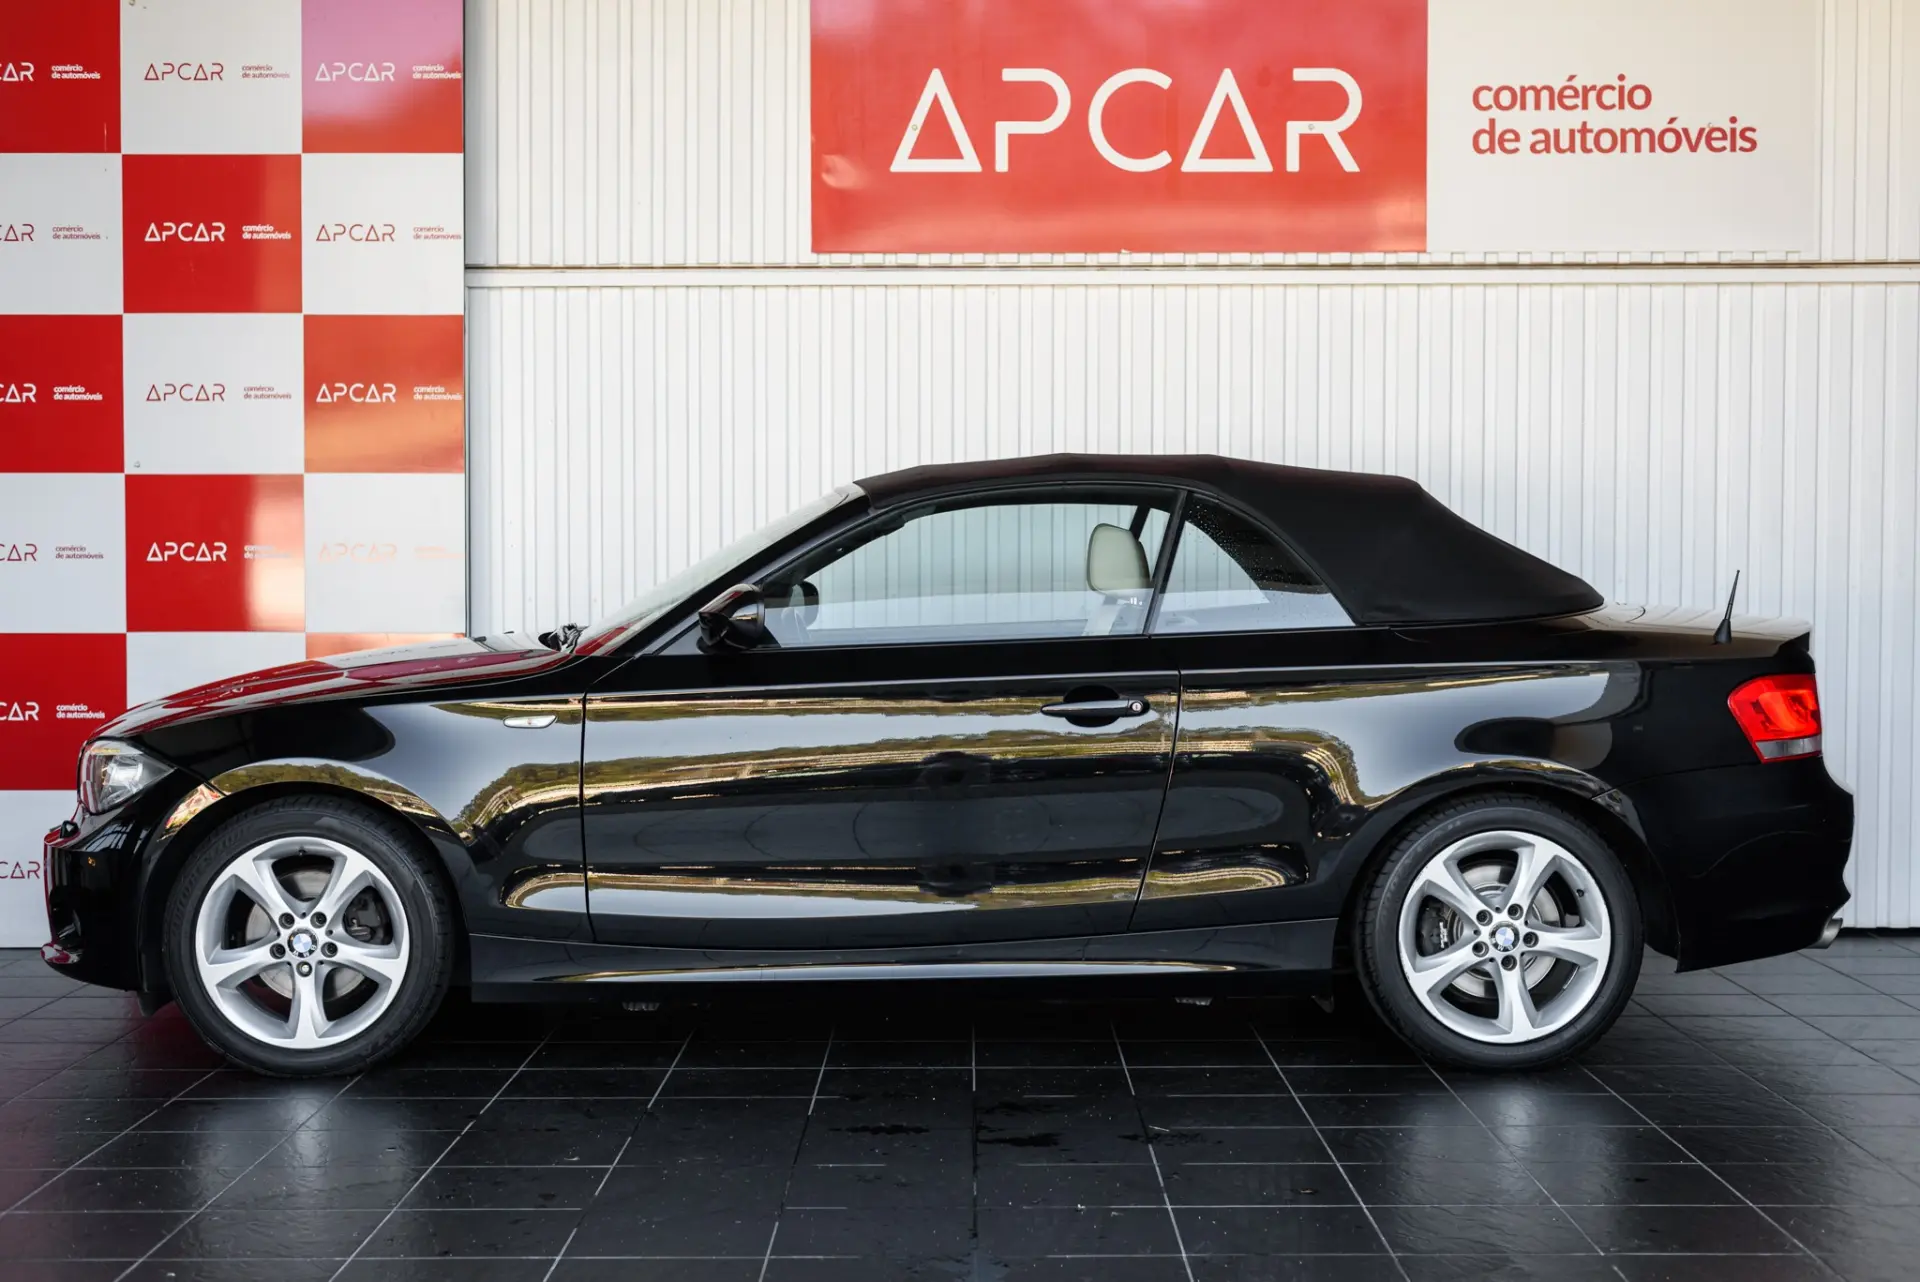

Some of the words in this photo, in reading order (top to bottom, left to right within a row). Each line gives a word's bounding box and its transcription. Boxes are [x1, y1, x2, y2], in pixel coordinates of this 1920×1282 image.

[0, 62, 34, 81] AR
[144, 63, 224, 81] APCAR
[315, 63, 395, 81] APCAR
[1472, 73, 1652, 111] comércio
[890, 68, 1362, 172] APCAR
[1472, 117, 1522, 155] de
[1530, 116, 1758, 154] automóveis
[0, 224, 34, 241] AR
[52, 232, 61, 240] de
[144, 223, 225, 242] APCAR
[242, 232, 252, 240] de
[316, 224, 396, 242] APCAR
[0, 383, 36, 403] AR
[146, 384, 226, 402] APCAR
[244, 392, 252, 400] de
[316, 384, 396, 403] APCAR
[147, 542, 227, 562] APCAR
